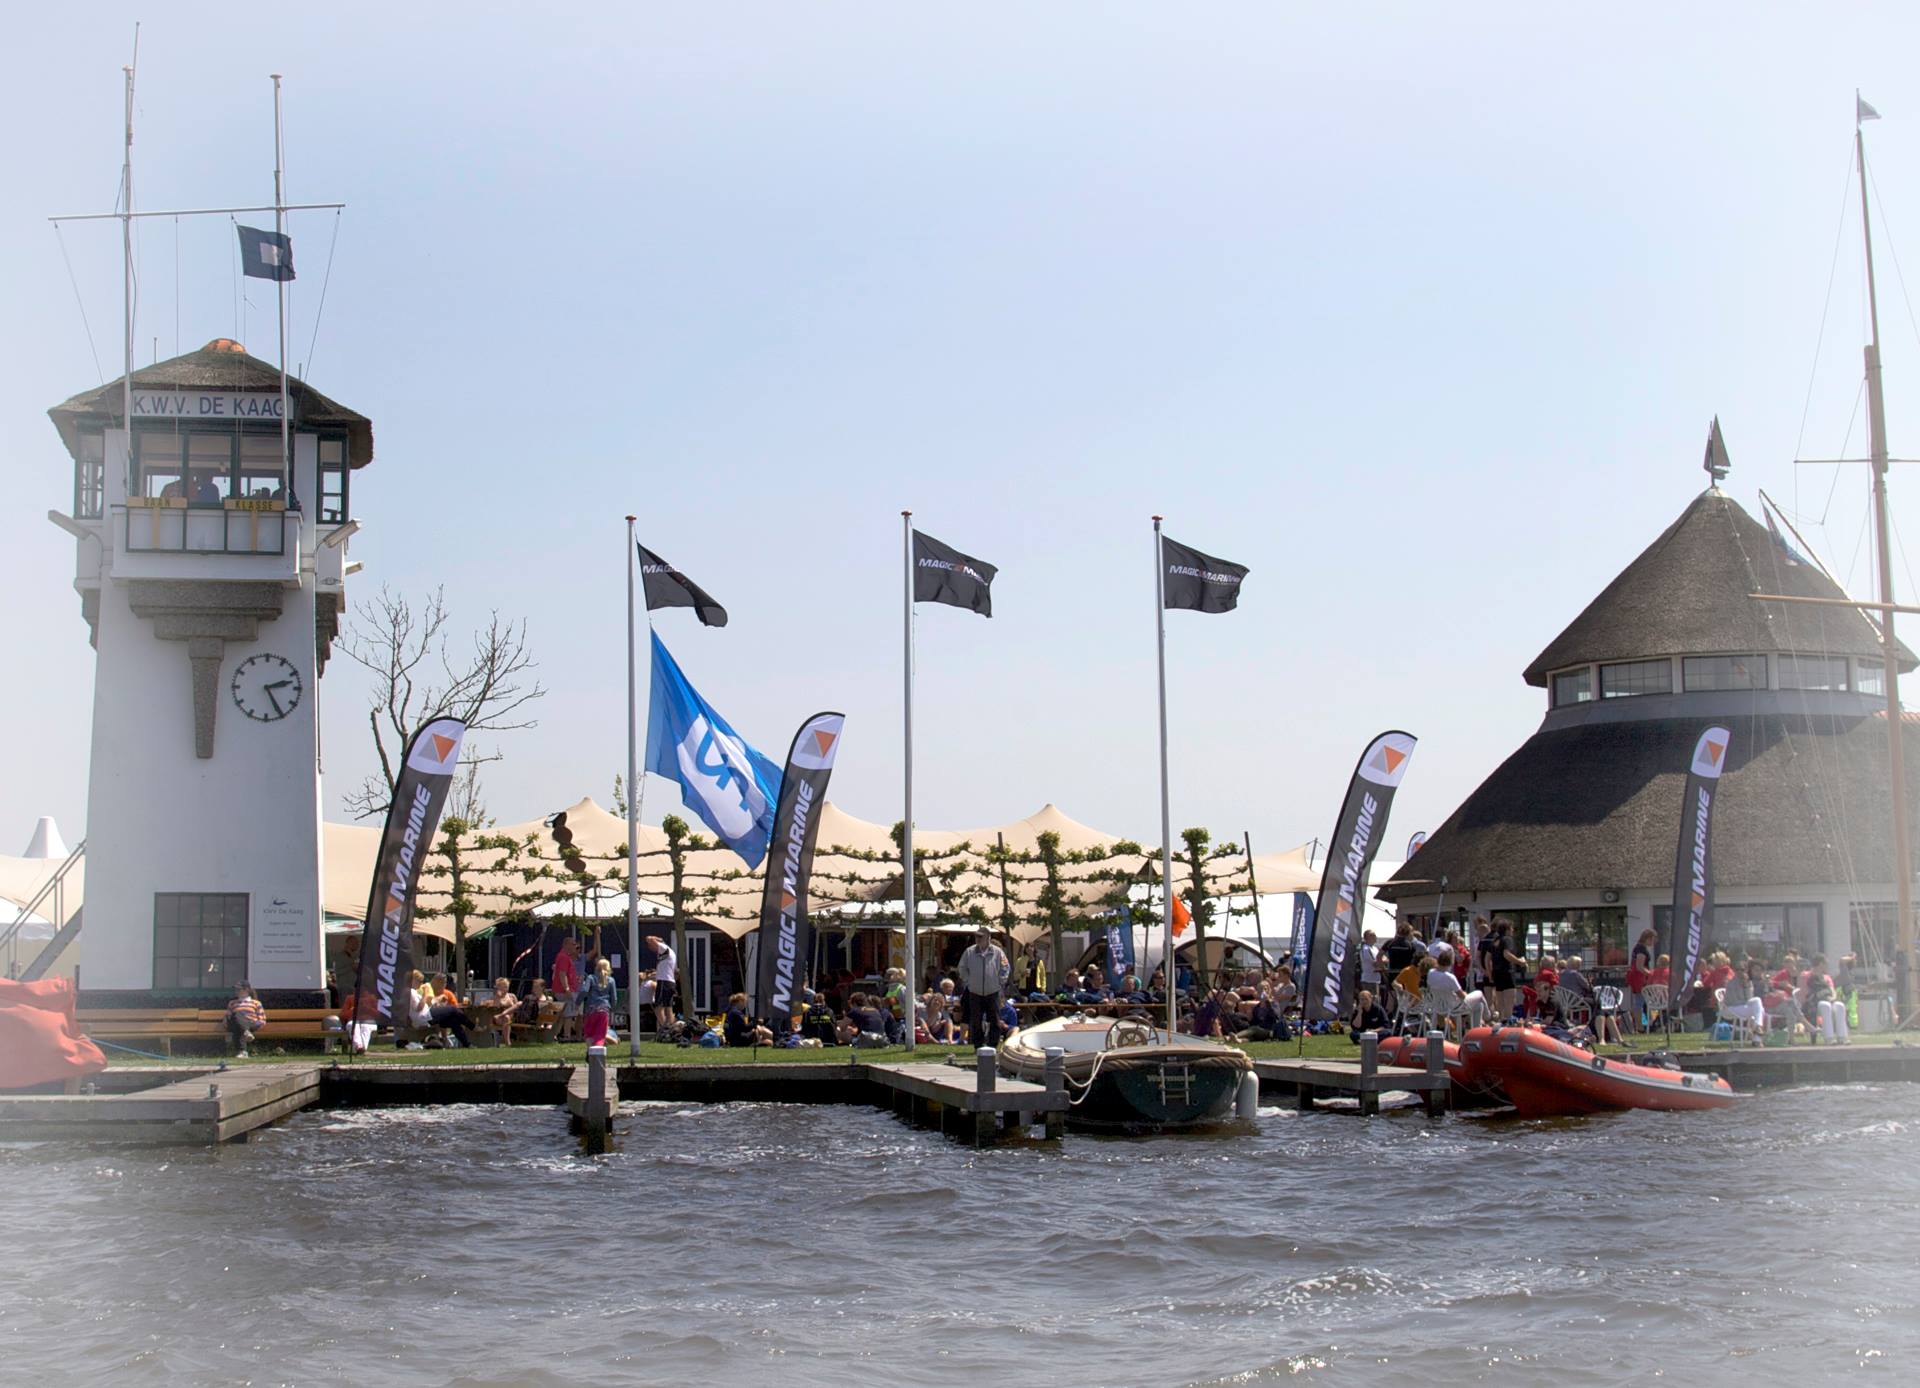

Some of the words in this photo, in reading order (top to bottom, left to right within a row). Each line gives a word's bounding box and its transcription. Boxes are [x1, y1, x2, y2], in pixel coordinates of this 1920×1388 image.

[133, 395, 190, 414] K.W.V.
[199, 396, 225, 415] DE
[233, 397, 284, 417] KAAG
[1169, 565, 1200, 577] MAGIC
[783, 778, 815, 897] MARINE
[1692, 785, 1711, 897] MARINE
[376, 918, 400, 1019] MAGIC
[390, 783, 432, 902] MARINE
[1323, 918, 1350, 1014] MAGIC
[1339, 792, 1378, 902] MARINE
[772, 914, 797, 1013] MAGIC
